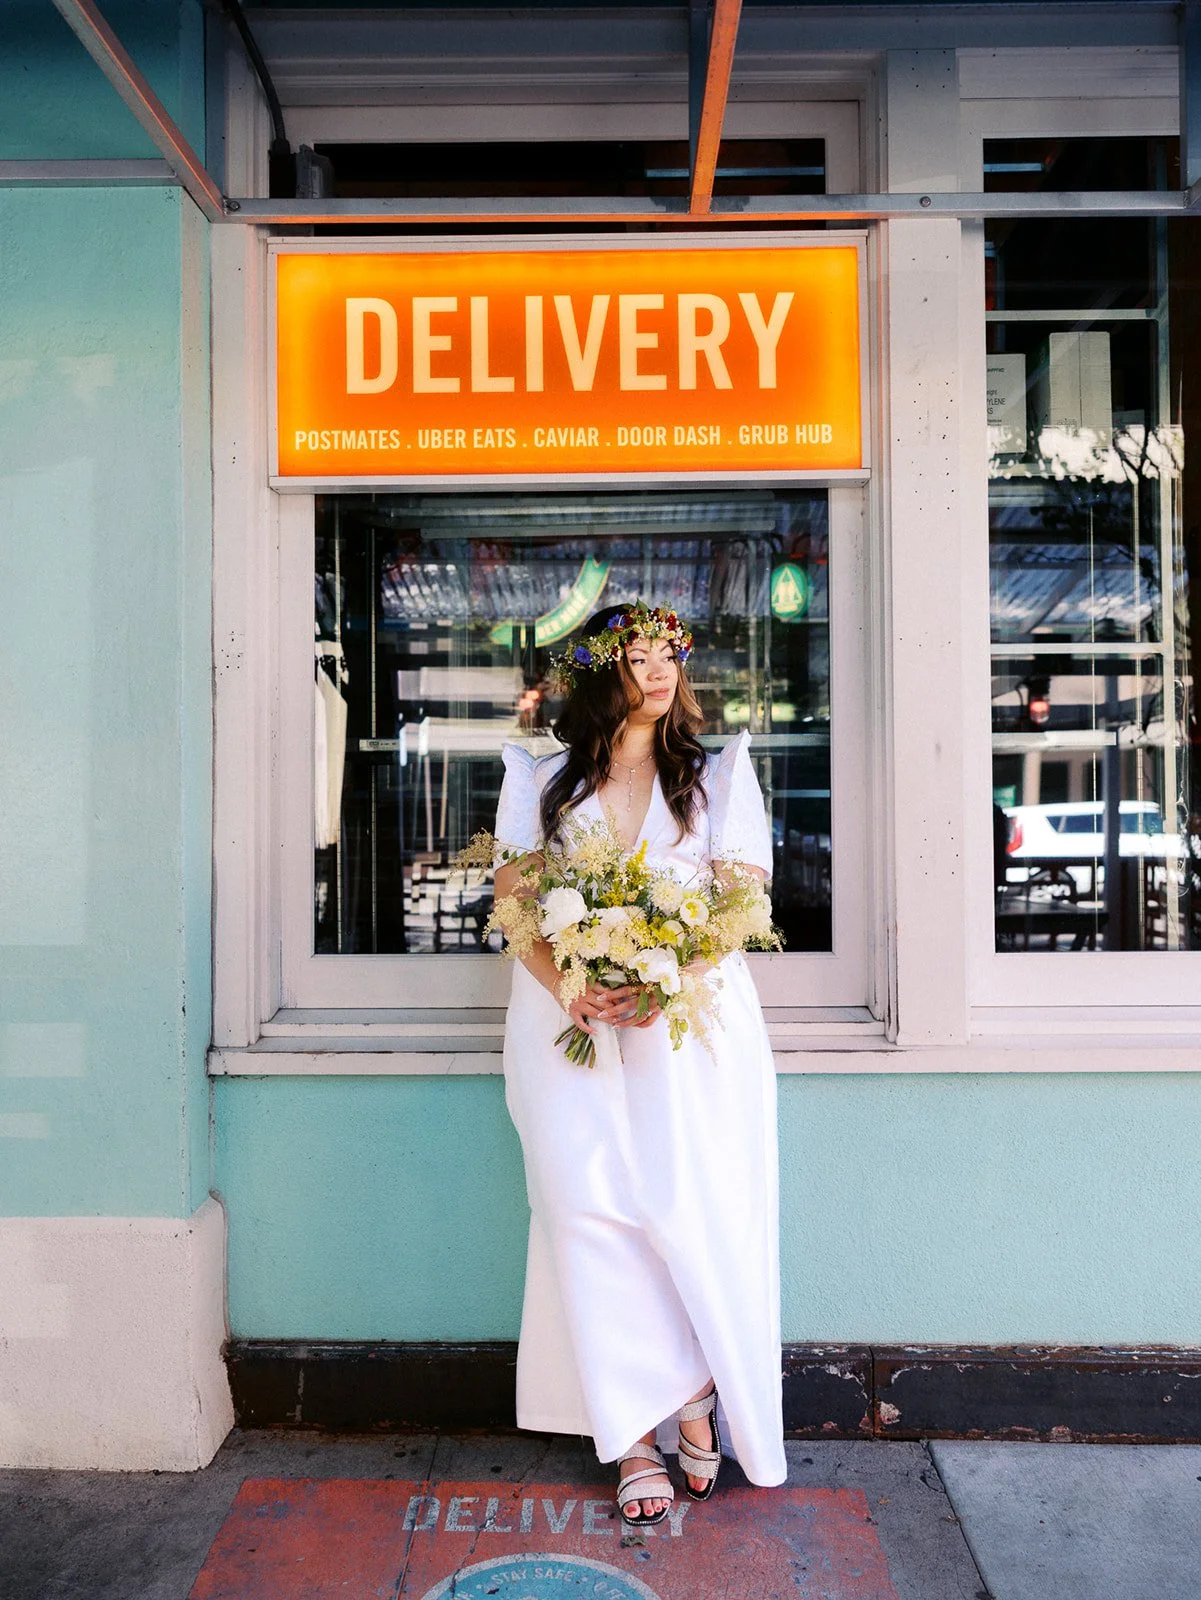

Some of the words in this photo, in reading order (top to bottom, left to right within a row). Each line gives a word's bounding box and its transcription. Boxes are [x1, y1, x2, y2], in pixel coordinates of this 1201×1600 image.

[346, 292, 795, 395] DELIVERY
[295, 429, 401, 450] POSTMATES
[418, 428, 467, 449] UBER
[473, 427, 516, 448] EATS
[534, 426, 600, 448] CAVIAR
[617, 426, 667, 446] DOOR
[673, 425, 721, 446] DASH
[738, 424, 789, 445] GRUB
[795, 423, 833, 444] HUB
[491, 1569, 528, 1584] STAY
[535, 1568, 575, 1582] SAFE
